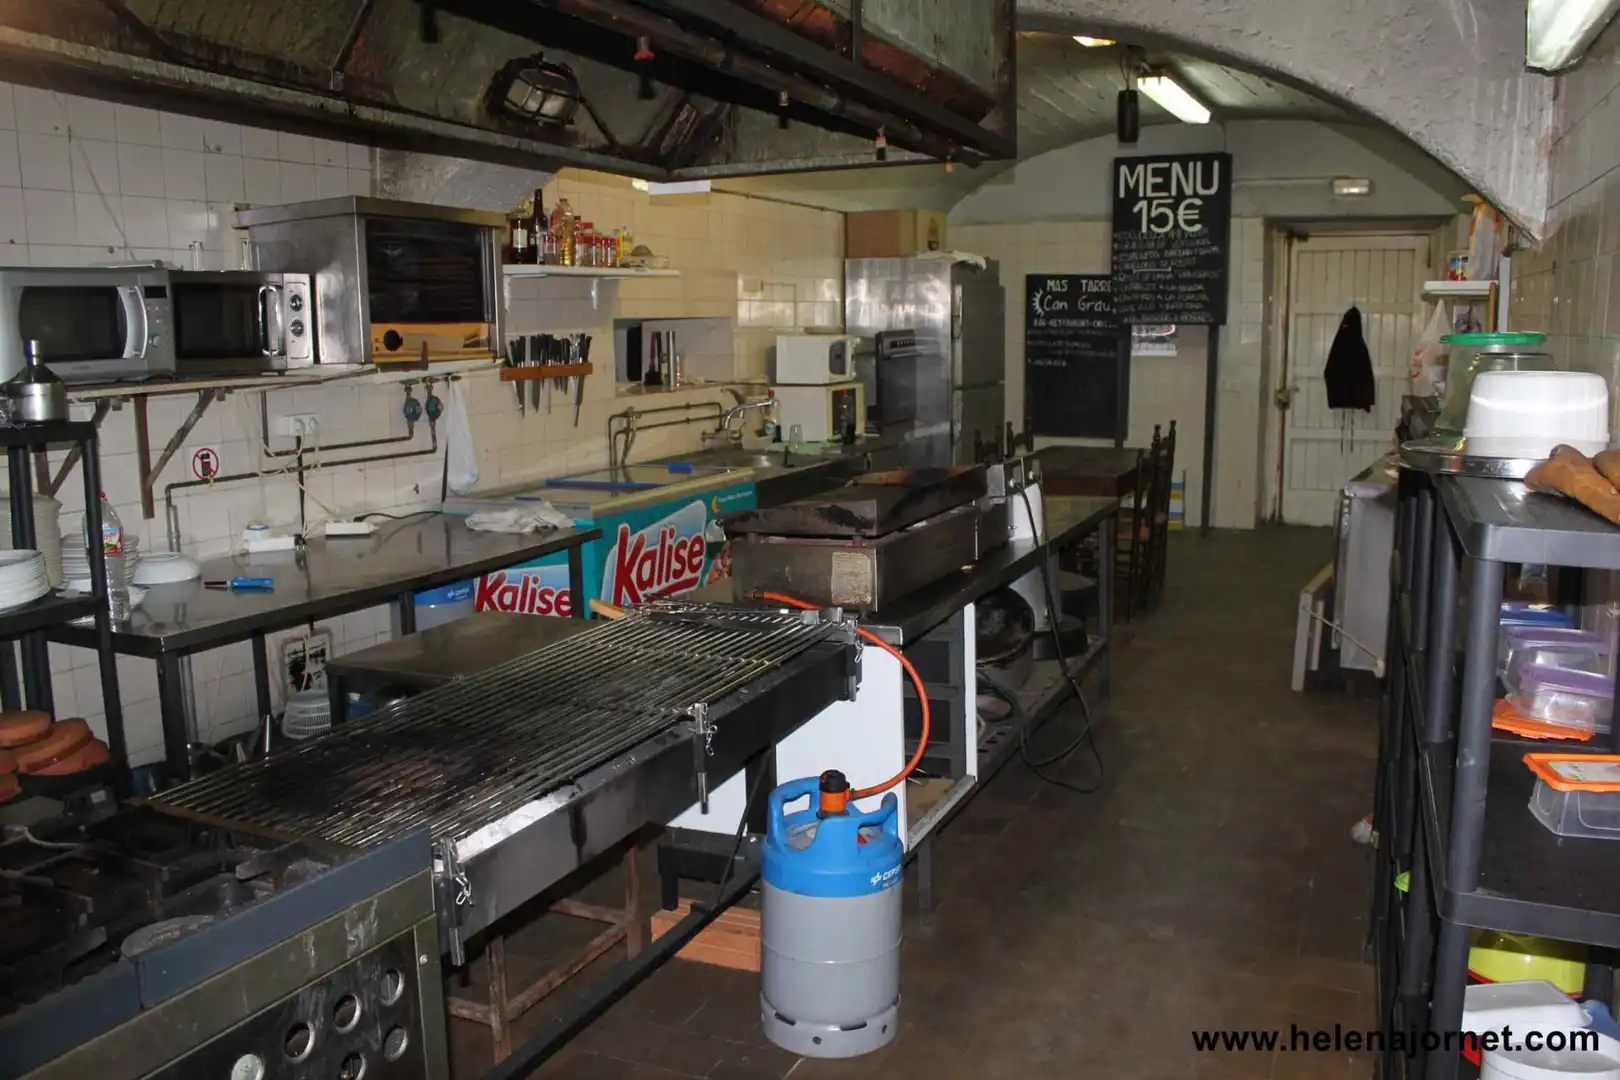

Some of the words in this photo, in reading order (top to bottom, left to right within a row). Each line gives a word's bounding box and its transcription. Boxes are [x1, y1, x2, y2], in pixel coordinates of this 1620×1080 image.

[1119, 160, 1220, 199] MENU
[1132, 197, 1203, 233] 15€
[1043, 294, 1069, 311] Can
[1077, 294, 1111, 312] Grau
[1046, 279, 1069, 292] MAS
[613, 525, 705, 608] Kalise
[475, 571, 572, 617] Kalise
